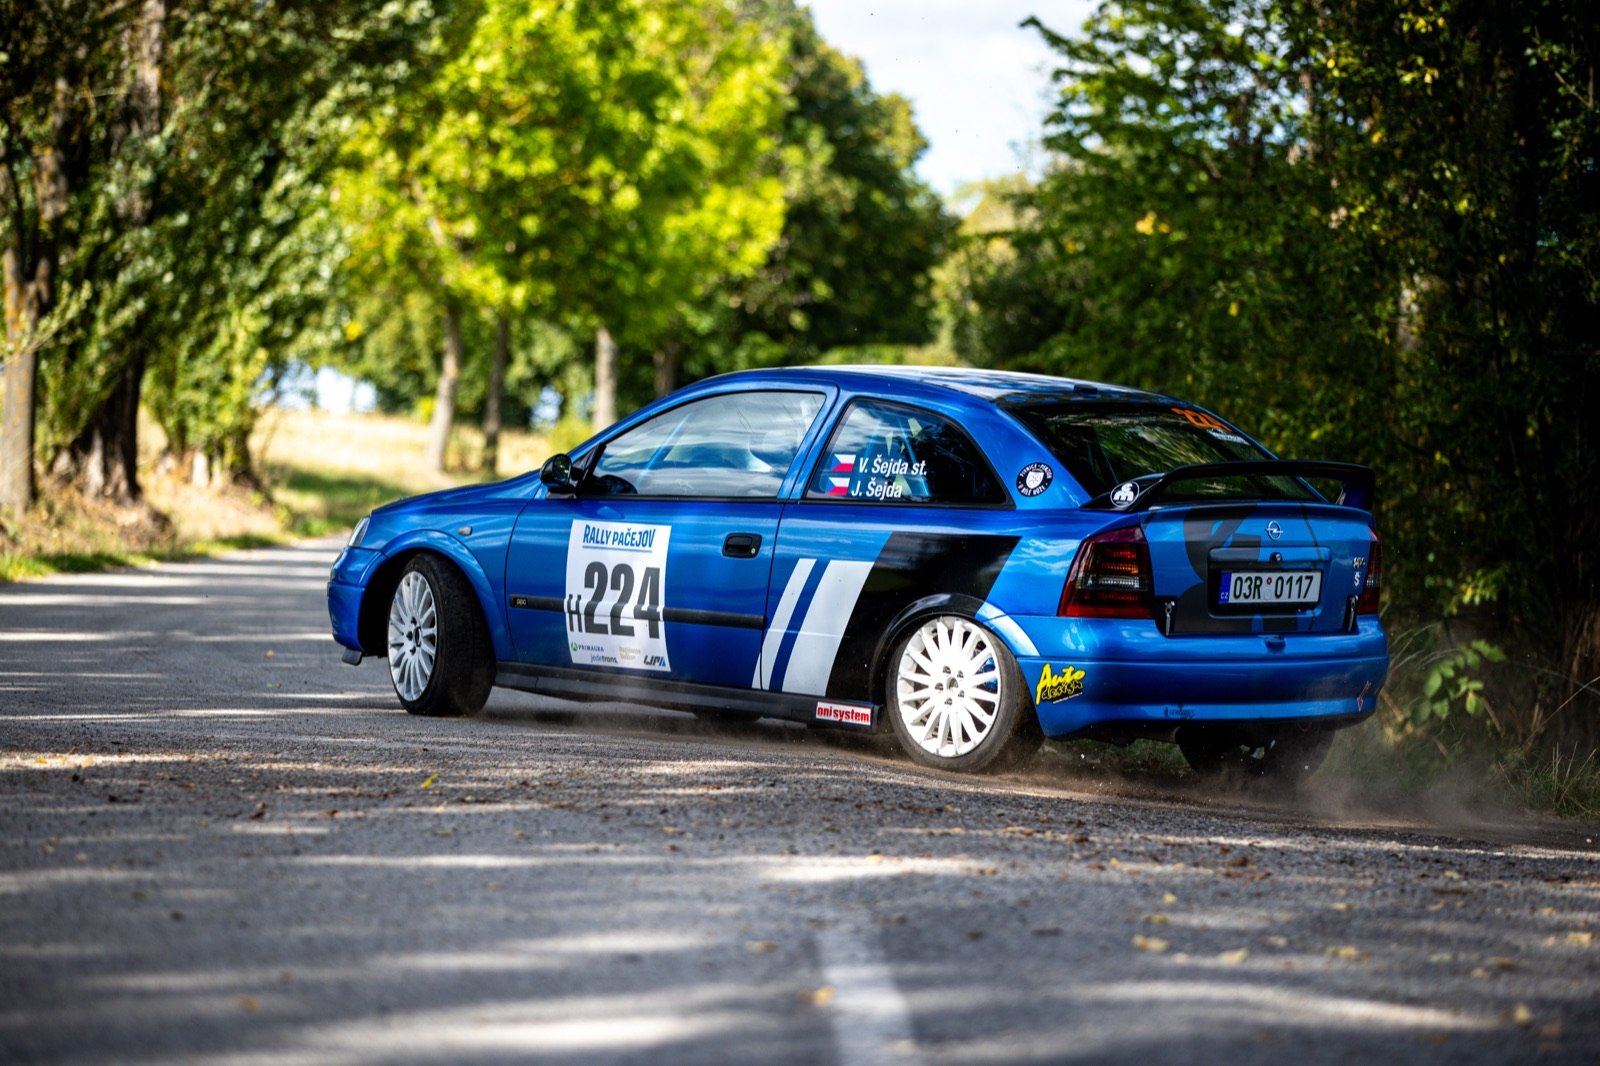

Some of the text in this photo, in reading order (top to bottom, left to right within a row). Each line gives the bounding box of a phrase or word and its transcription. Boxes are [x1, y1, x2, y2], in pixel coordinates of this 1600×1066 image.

[859, 454, 927, 477] V. Šejda st.
[851, 477, 903, 501] J. Šejda
[583, 524, 656, 548] RALLY PAČEJOV
[1036, 663, 1086, 704] Auto
